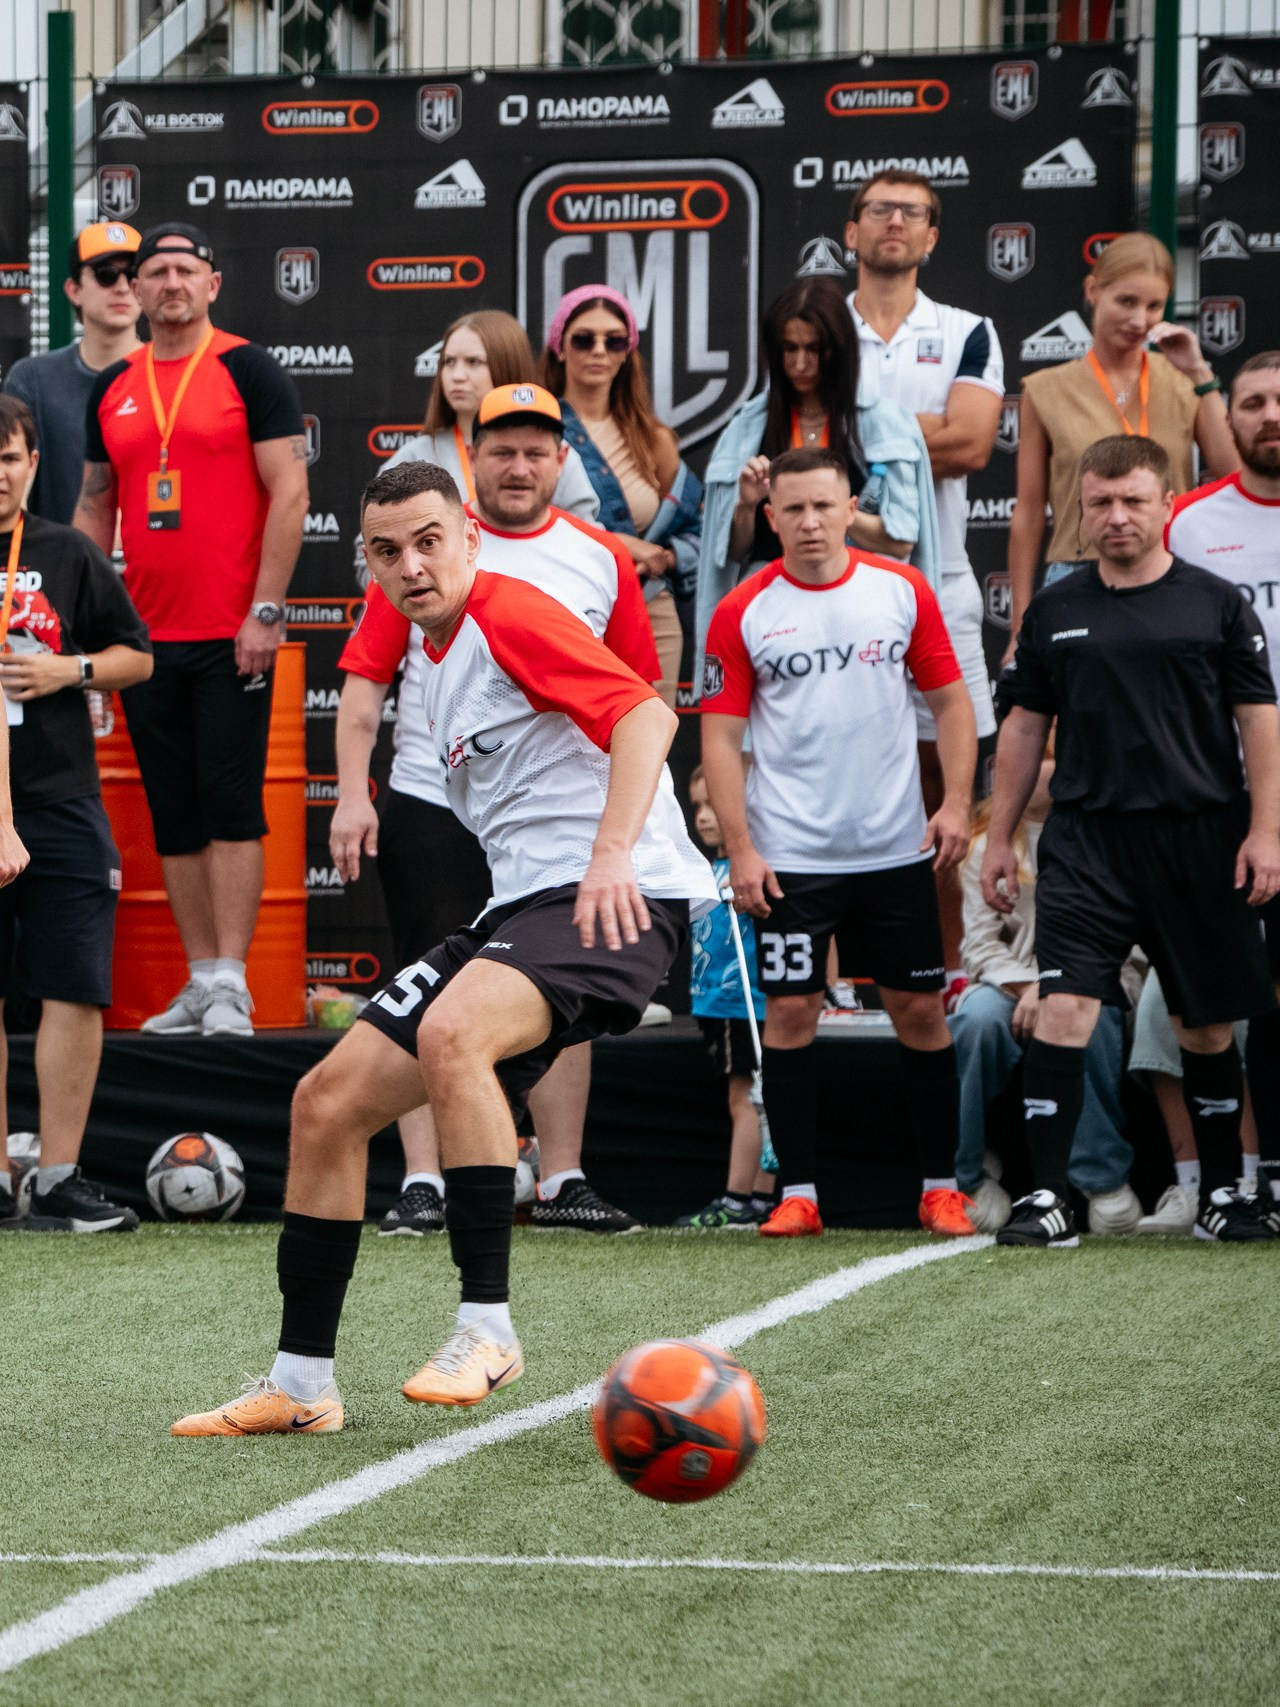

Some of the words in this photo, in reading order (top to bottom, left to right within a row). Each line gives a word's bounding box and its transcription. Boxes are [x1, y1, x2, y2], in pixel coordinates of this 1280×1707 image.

[537, 95, 670, 120] ПАНОРАМА
[837, 90, 913, 108] Winline
[168, 112, 225, 127] ВОСТОК
[273, 109, 347, 127] Winline
[832, 156, 970, 184] ПАНОРАМА
[225, 177, 354, 199] ПАНОРАМА
[564, 194, 677, 220] Winline
[378, 264, 453, 284] Winline
[276, 345, 354, 366] ОРАМА
[764, 643, 855, 681] ХОТУ
[760, 932, 813, 982] 33
